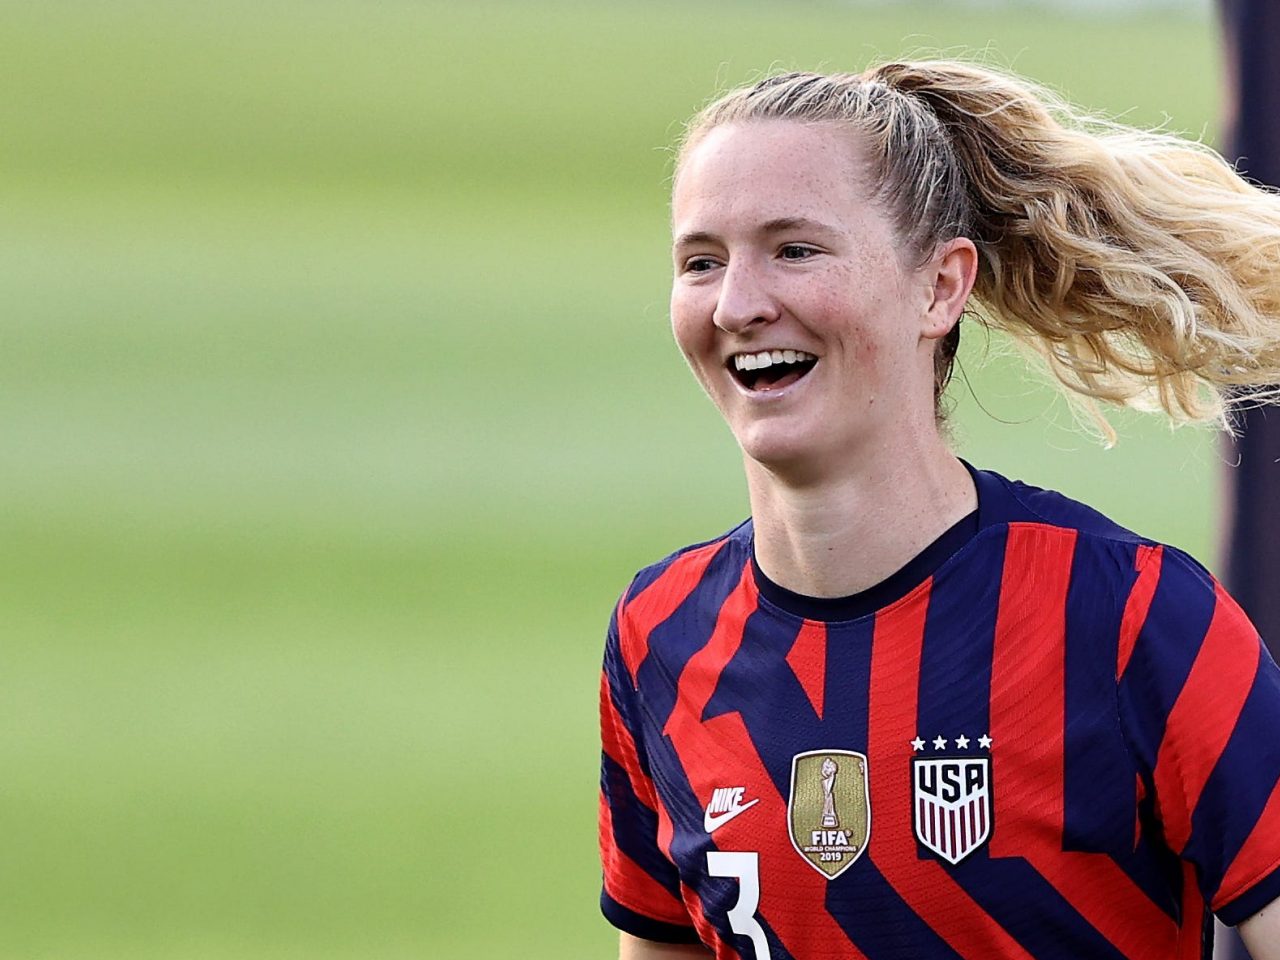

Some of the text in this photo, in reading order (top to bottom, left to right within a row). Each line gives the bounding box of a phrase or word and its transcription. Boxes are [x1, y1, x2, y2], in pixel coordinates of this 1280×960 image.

[919, 763, 984, 804] USA
[710, 787, 745, 813] NIKE
[811, 830, 848, 846] FIFA
[820, 852, 842, 861] 2019
